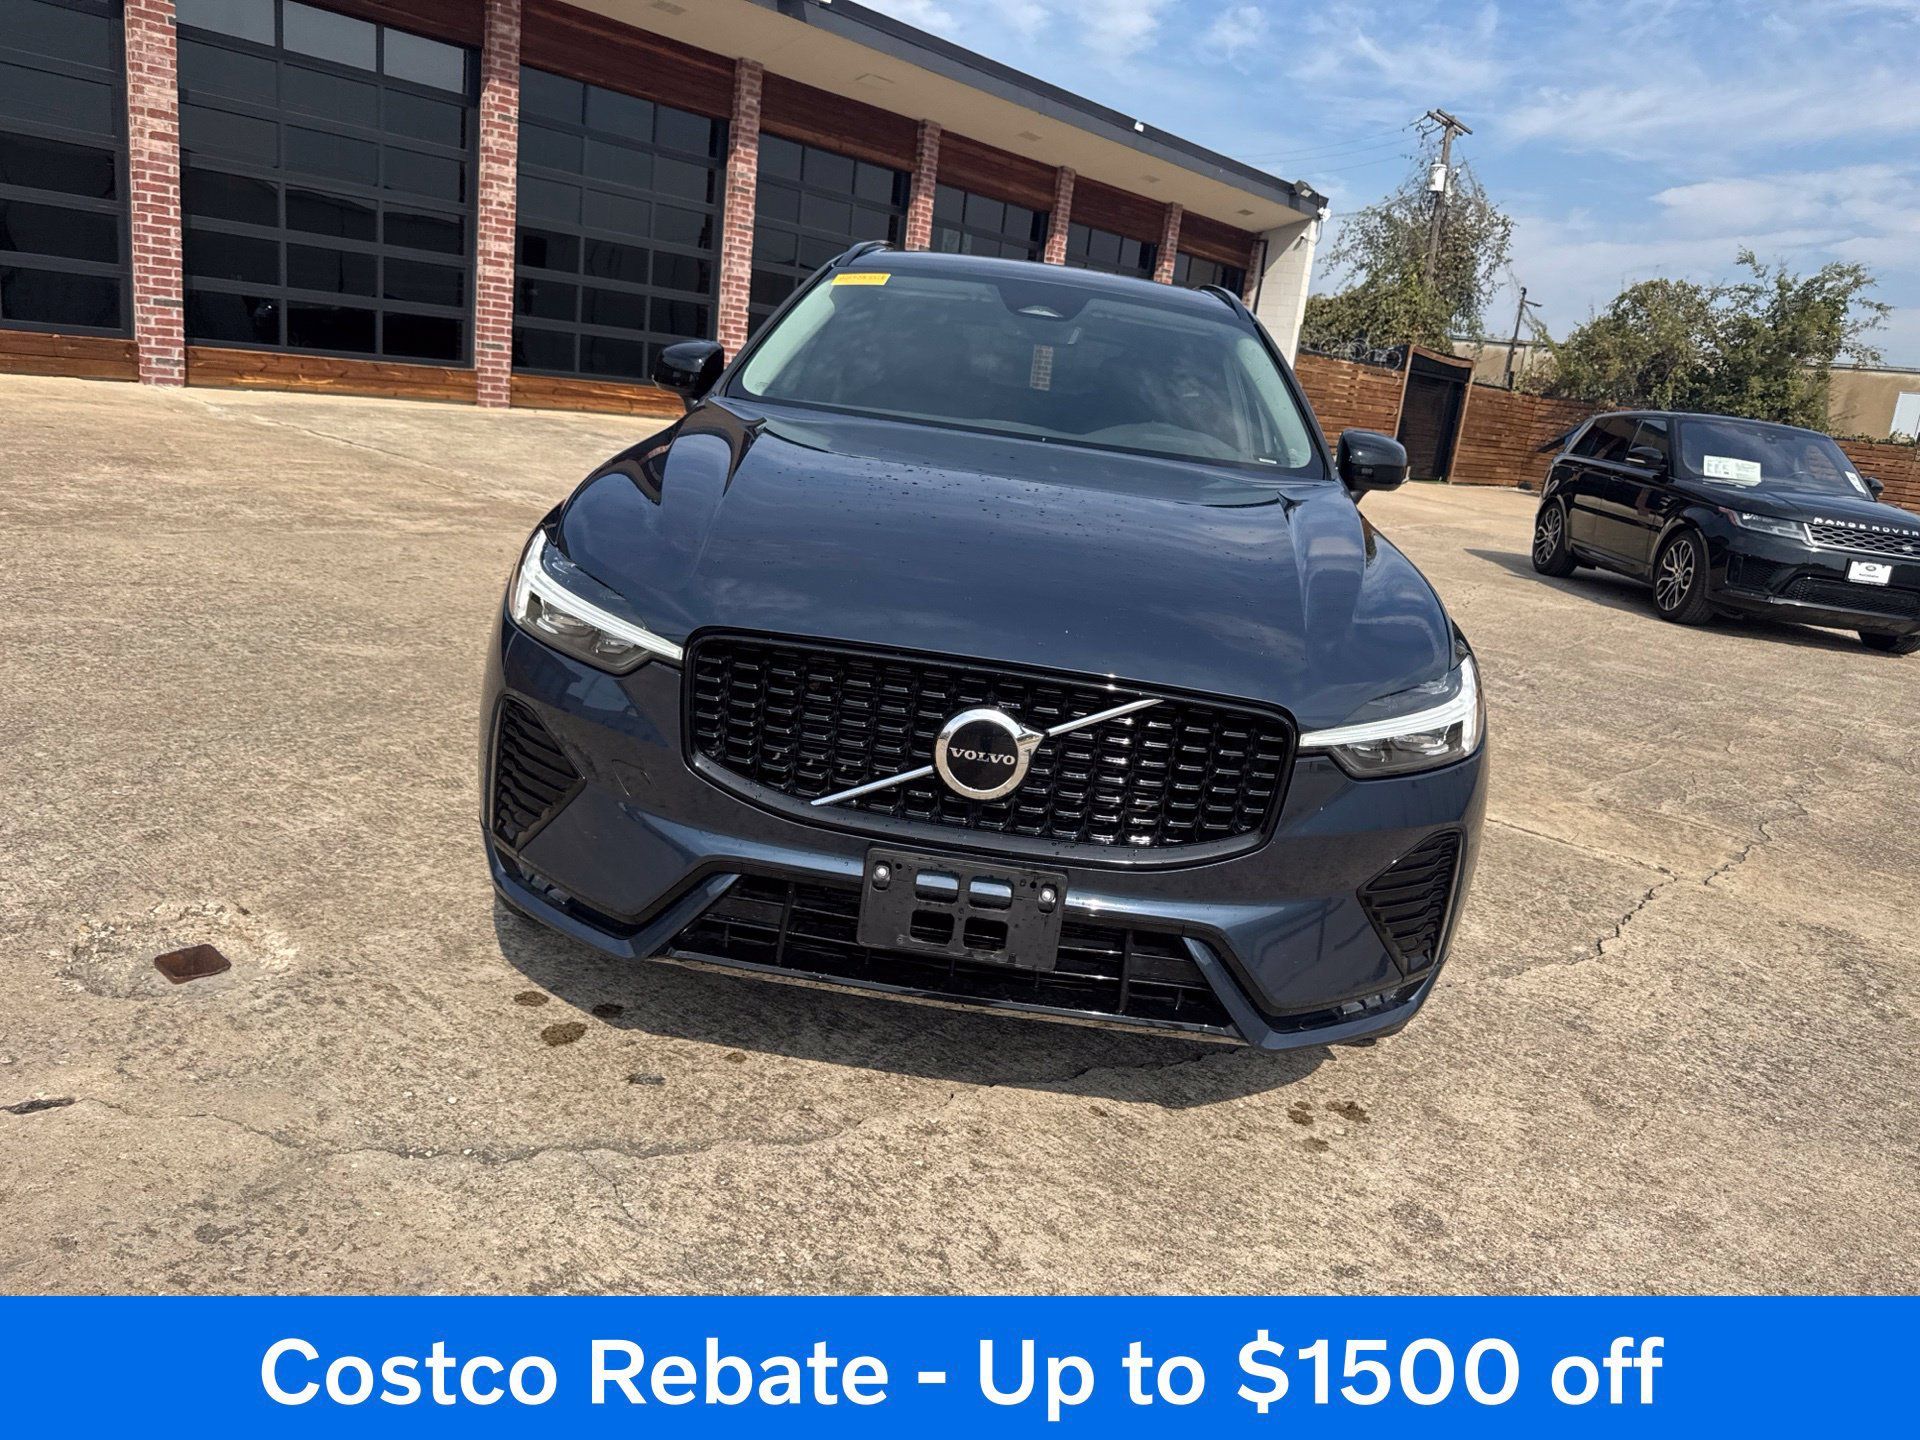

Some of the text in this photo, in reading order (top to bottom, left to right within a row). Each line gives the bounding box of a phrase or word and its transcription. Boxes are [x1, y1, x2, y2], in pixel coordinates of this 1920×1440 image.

[1813, 517, 1920, 537] RANGE ROVER
[949, 747, 1016, 765] VOLVO
